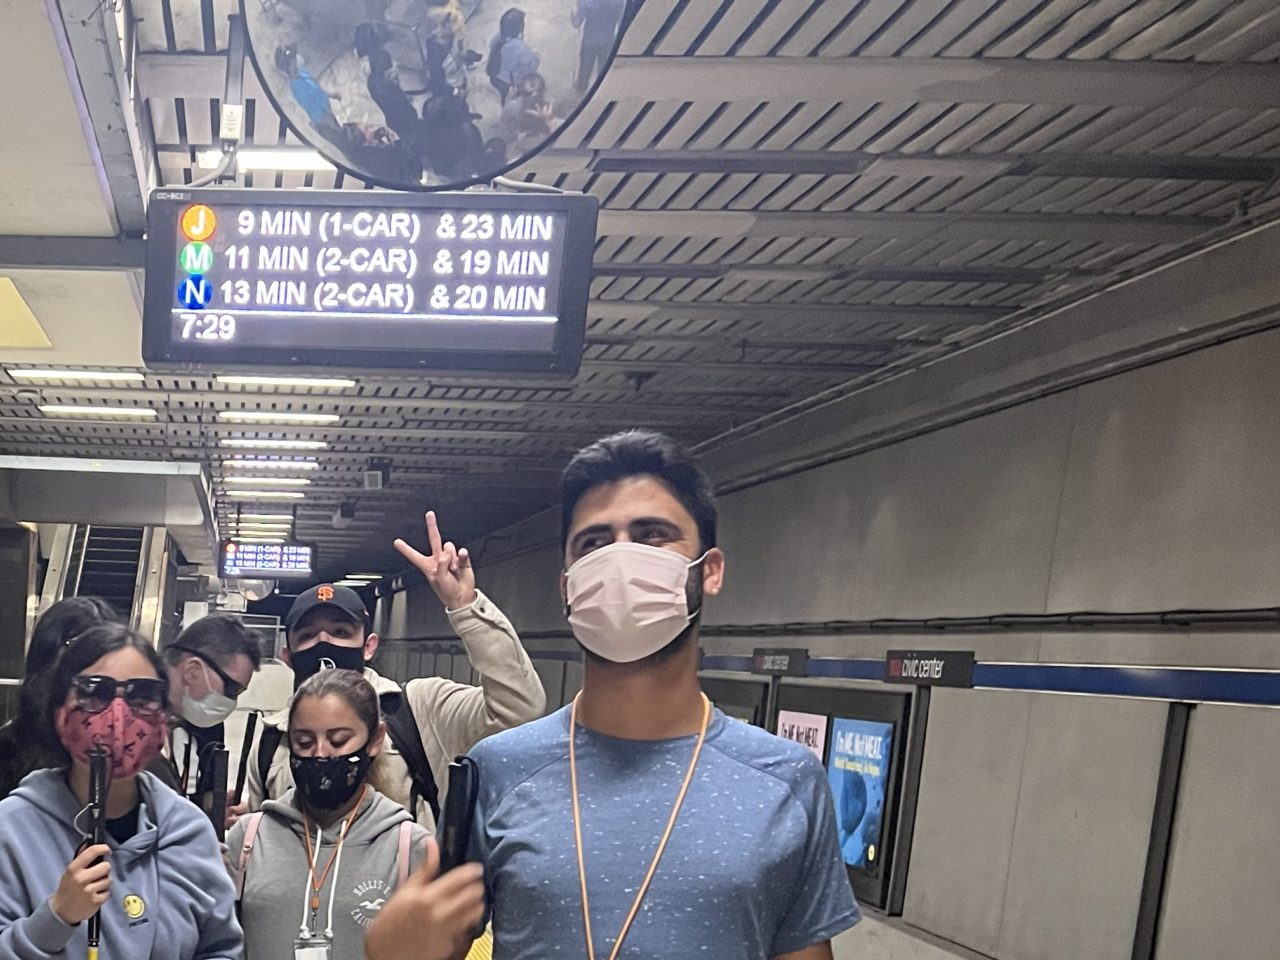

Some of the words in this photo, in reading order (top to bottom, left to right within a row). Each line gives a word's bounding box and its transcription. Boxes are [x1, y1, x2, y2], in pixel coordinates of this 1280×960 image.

[191, 210, 206, 234] J
[237, 210, 255, 235] 9
[260, 210, 311, 235] MIN
[319, 211, 421, 244] (1-CAR)
[436, 213, 456, 238] &
[460, 214, 494, 239] 23
[500, 214, 553, 240] MIN
[185, 244, 211, 270] M
[224, 245, 250, 270] 11
[258, 245, 308, 270] MIN
[316, 247, 417, 279] (2-CAR)
[433, 249, 453, 274] &
[460, 250, 491, 275] 19
[496, 250, 549, 275] MIN
[185, 280, 205, 304] N
[220, 280, 250, 304] 13
[256, 280, 306, 305] MIN
[313, 281, 414, 313] (2-CAR)
[430, 284, 449, 309] &
[454, 284, 487, 310] 20
[493, 285, 546, 311] MIN
[179, 314, 236, 340] 7:29
[901, 652, 918, 677] civic
[919, 656, 944, 678] center
